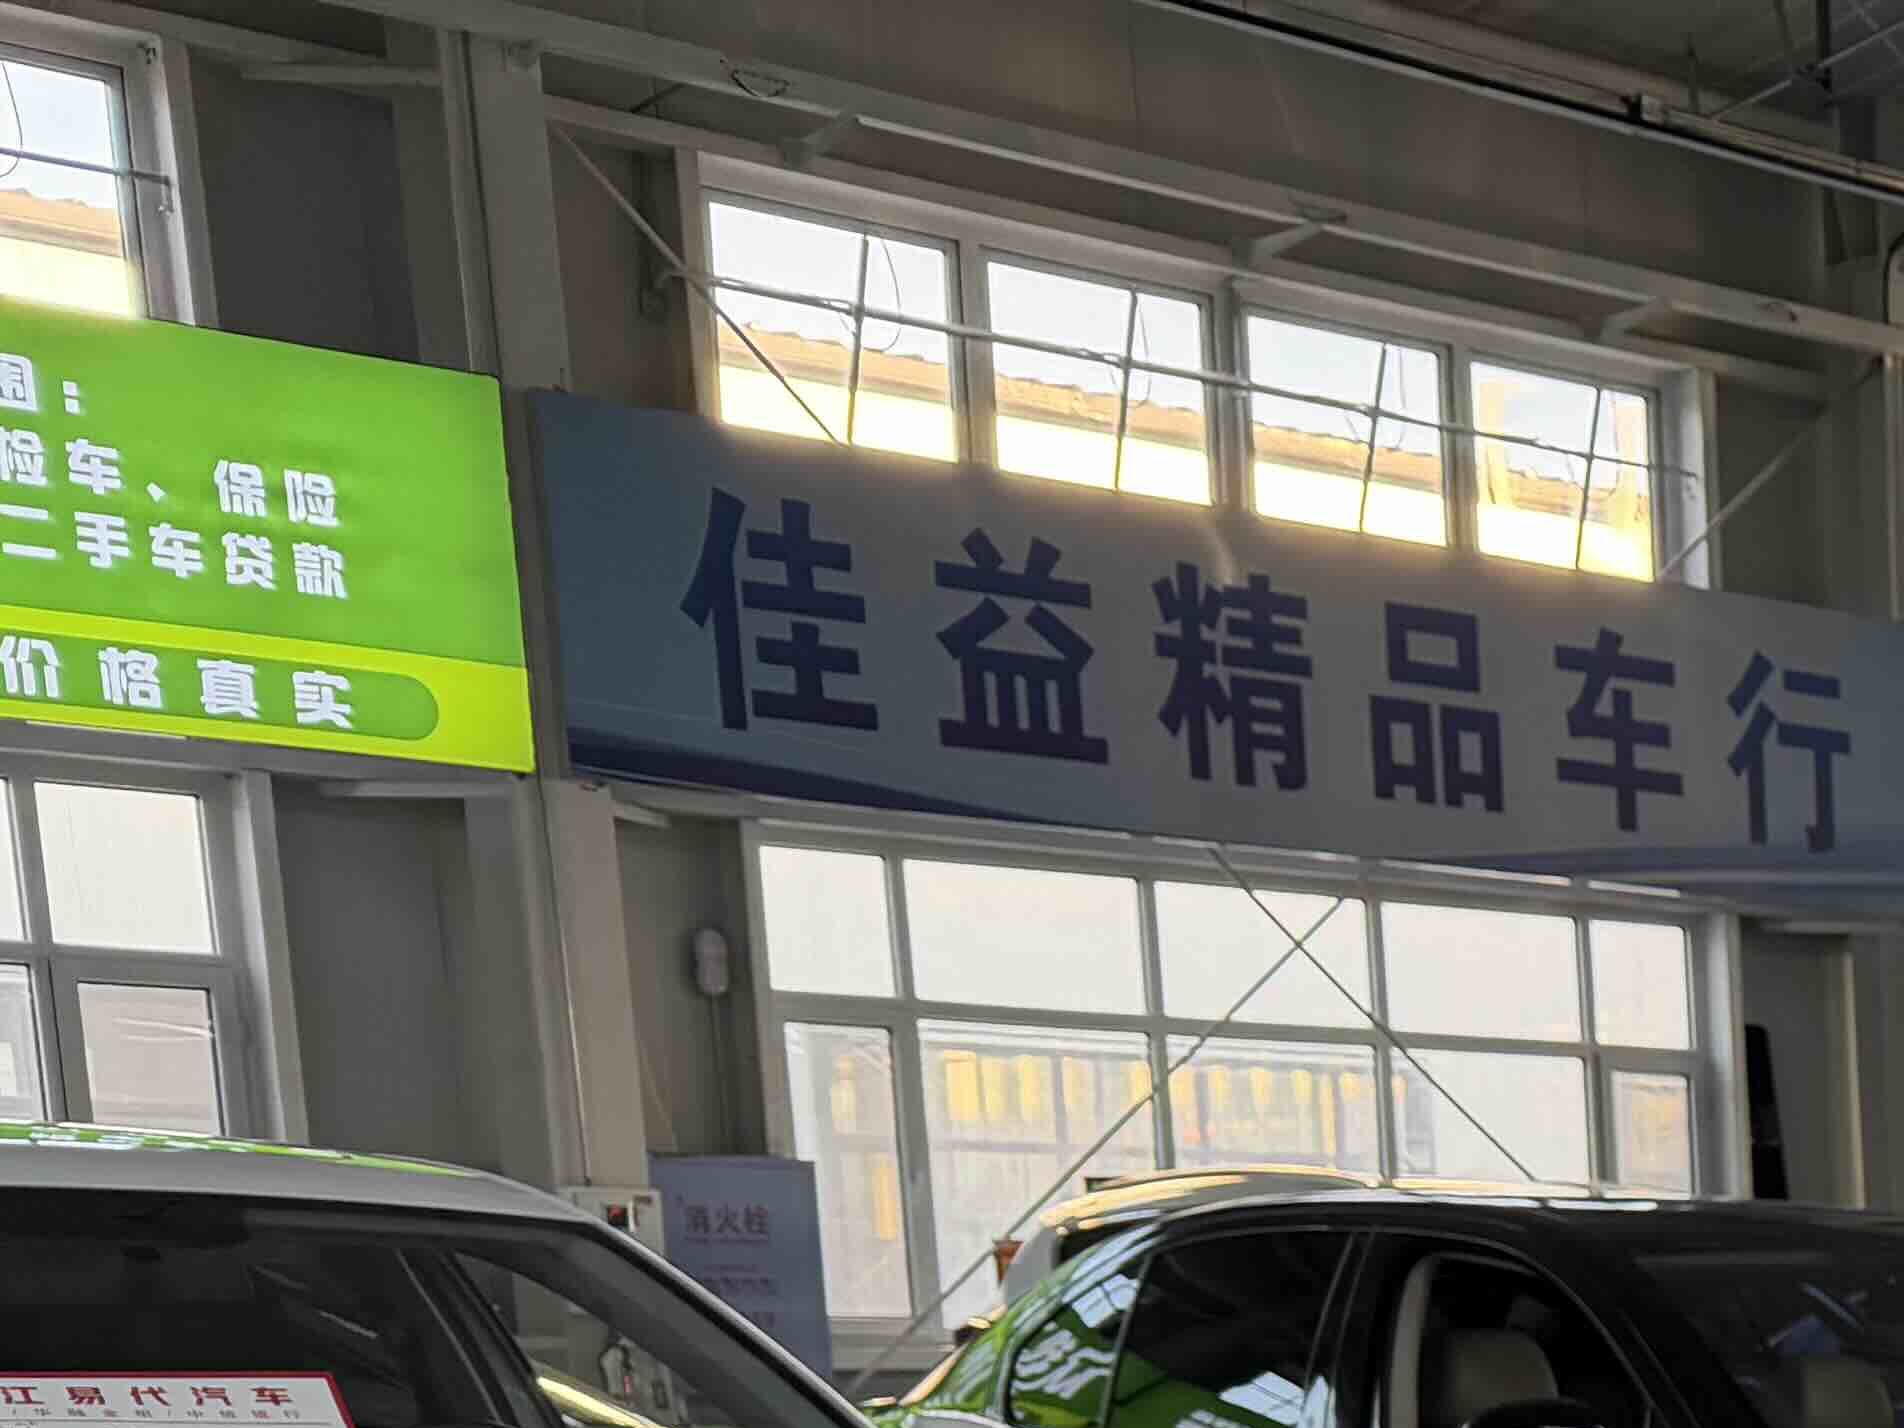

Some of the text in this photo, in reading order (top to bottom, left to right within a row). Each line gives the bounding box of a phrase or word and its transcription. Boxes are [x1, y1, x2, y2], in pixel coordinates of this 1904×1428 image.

[0, 503, 347, 599] 二手车贷款
[0, 635, 352, 729] 价格真实
[679, 486, 1852, 855] 佳益精品车行
